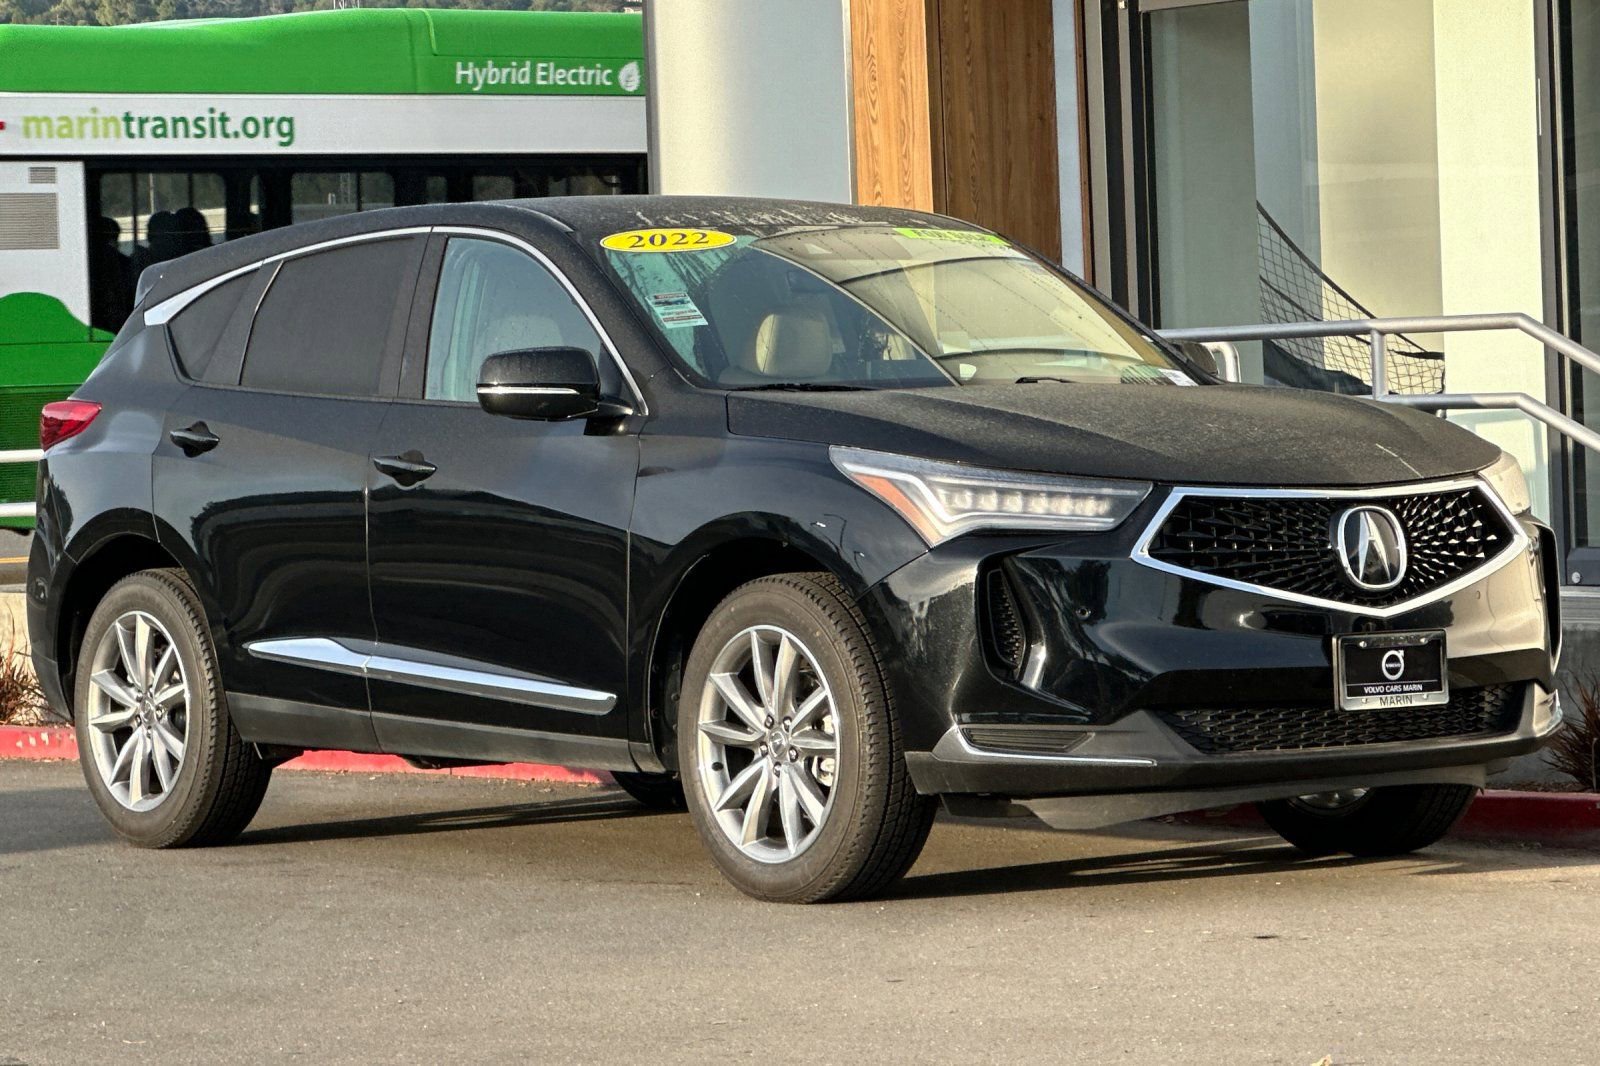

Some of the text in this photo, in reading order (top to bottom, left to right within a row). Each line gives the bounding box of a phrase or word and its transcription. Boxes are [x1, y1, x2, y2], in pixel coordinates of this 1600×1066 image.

[455, 60, 613, 92] Hybrid Electric
[22, 107, 295, 147] marintransit.org
[627, 232, 710, 248] 2022
[1380, 695, 1413, 706] MARIN
